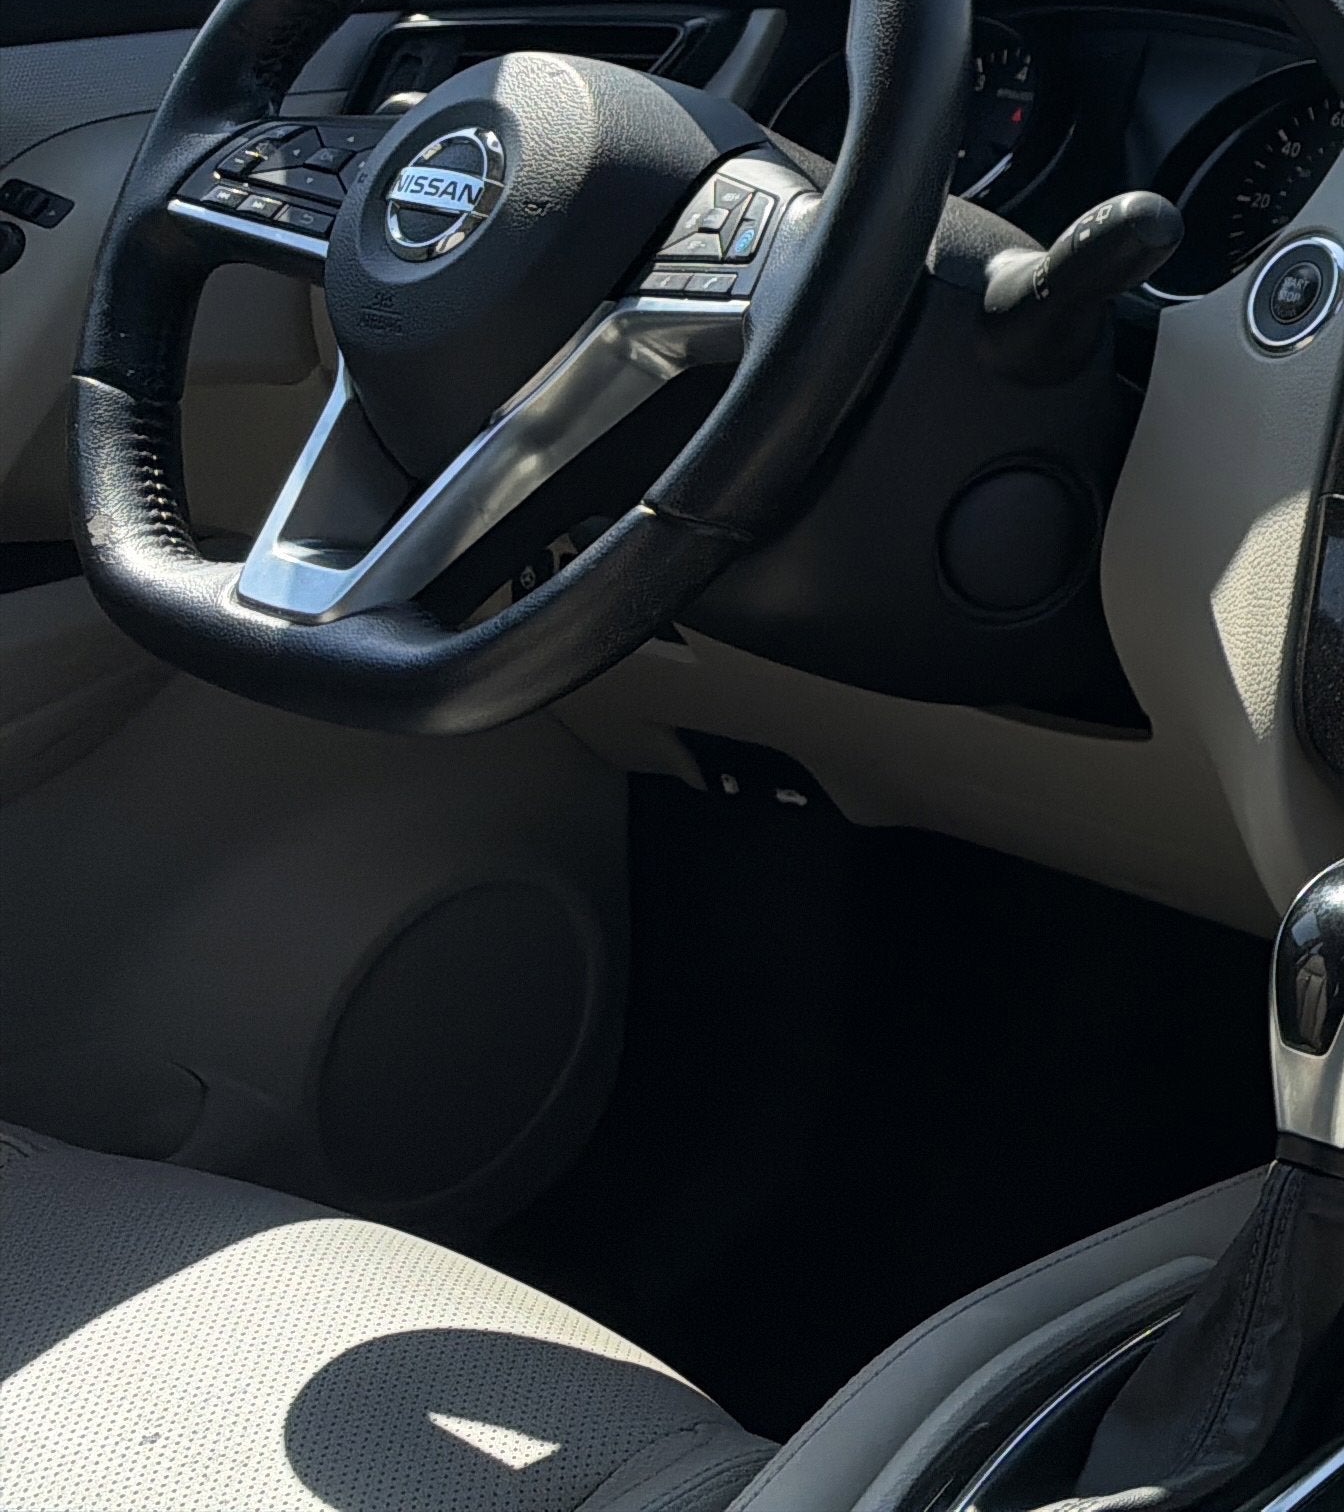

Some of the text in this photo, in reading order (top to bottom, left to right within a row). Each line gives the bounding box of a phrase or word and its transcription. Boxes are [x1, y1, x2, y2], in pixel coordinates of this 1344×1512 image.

[1281, 141, 1302, 158] 40
[391, 174, 485, 208] NISSAN
[1251, 192, 1271, 209] 20
